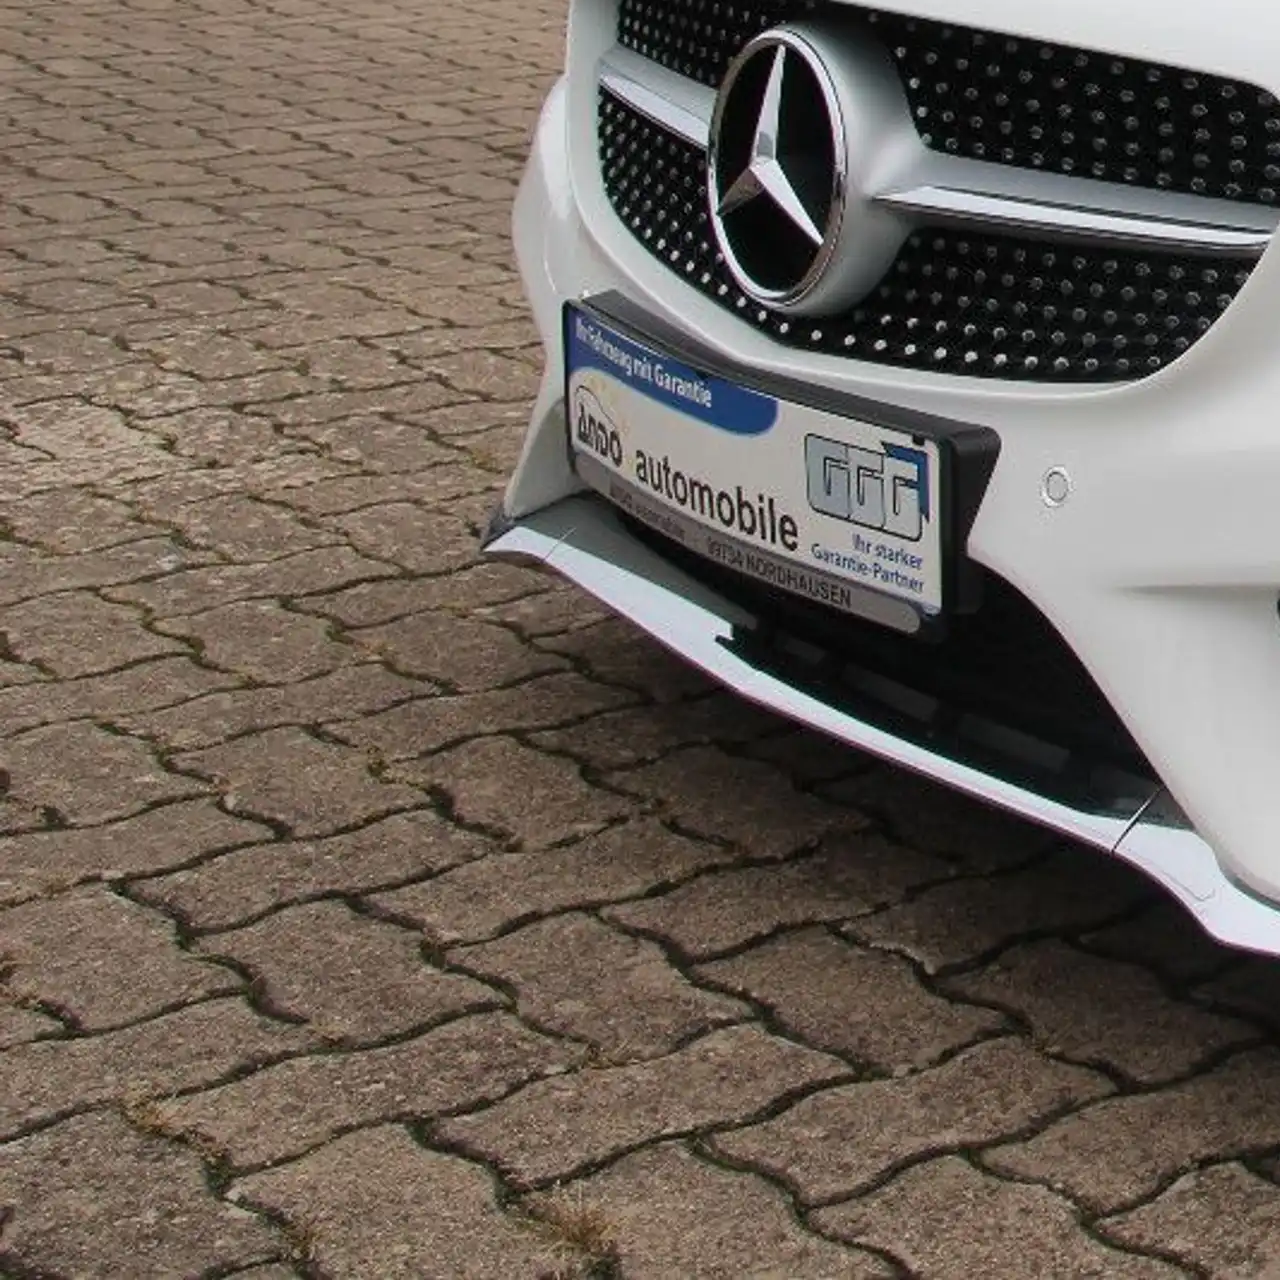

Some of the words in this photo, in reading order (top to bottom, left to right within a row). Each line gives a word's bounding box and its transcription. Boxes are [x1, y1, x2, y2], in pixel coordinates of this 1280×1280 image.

[655, 363, 712, 408] Garantie
[635, 449, 799, 552] automobile
[811, 543, 925, 592] Garantie-Partner
[853, 532, 872, 554] Ihr
[875, 545, 924, 570] starker
[746, 551, 851, 605] NORDHAUSEN
